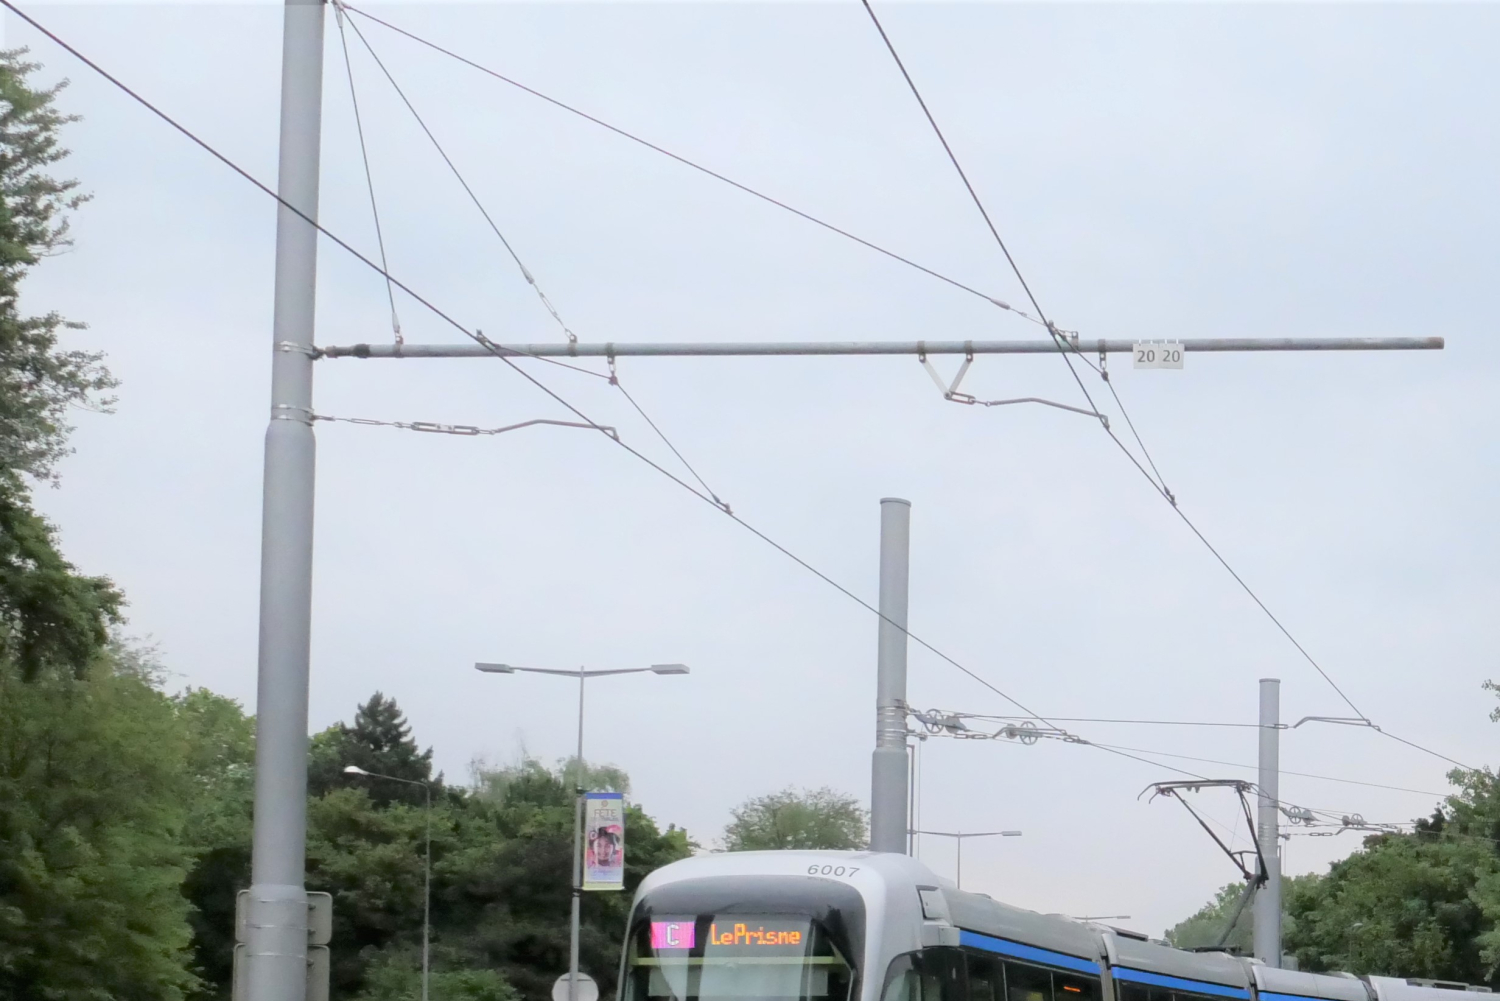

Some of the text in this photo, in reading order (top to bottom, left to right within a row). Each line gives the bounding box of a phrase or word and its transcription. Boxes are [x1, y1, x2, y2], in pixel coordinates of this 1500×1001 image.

[1137, 349, 1181, 363] 20 20
[807, 864, 861, 878] 6007
[666, 924, 680, 946] C
